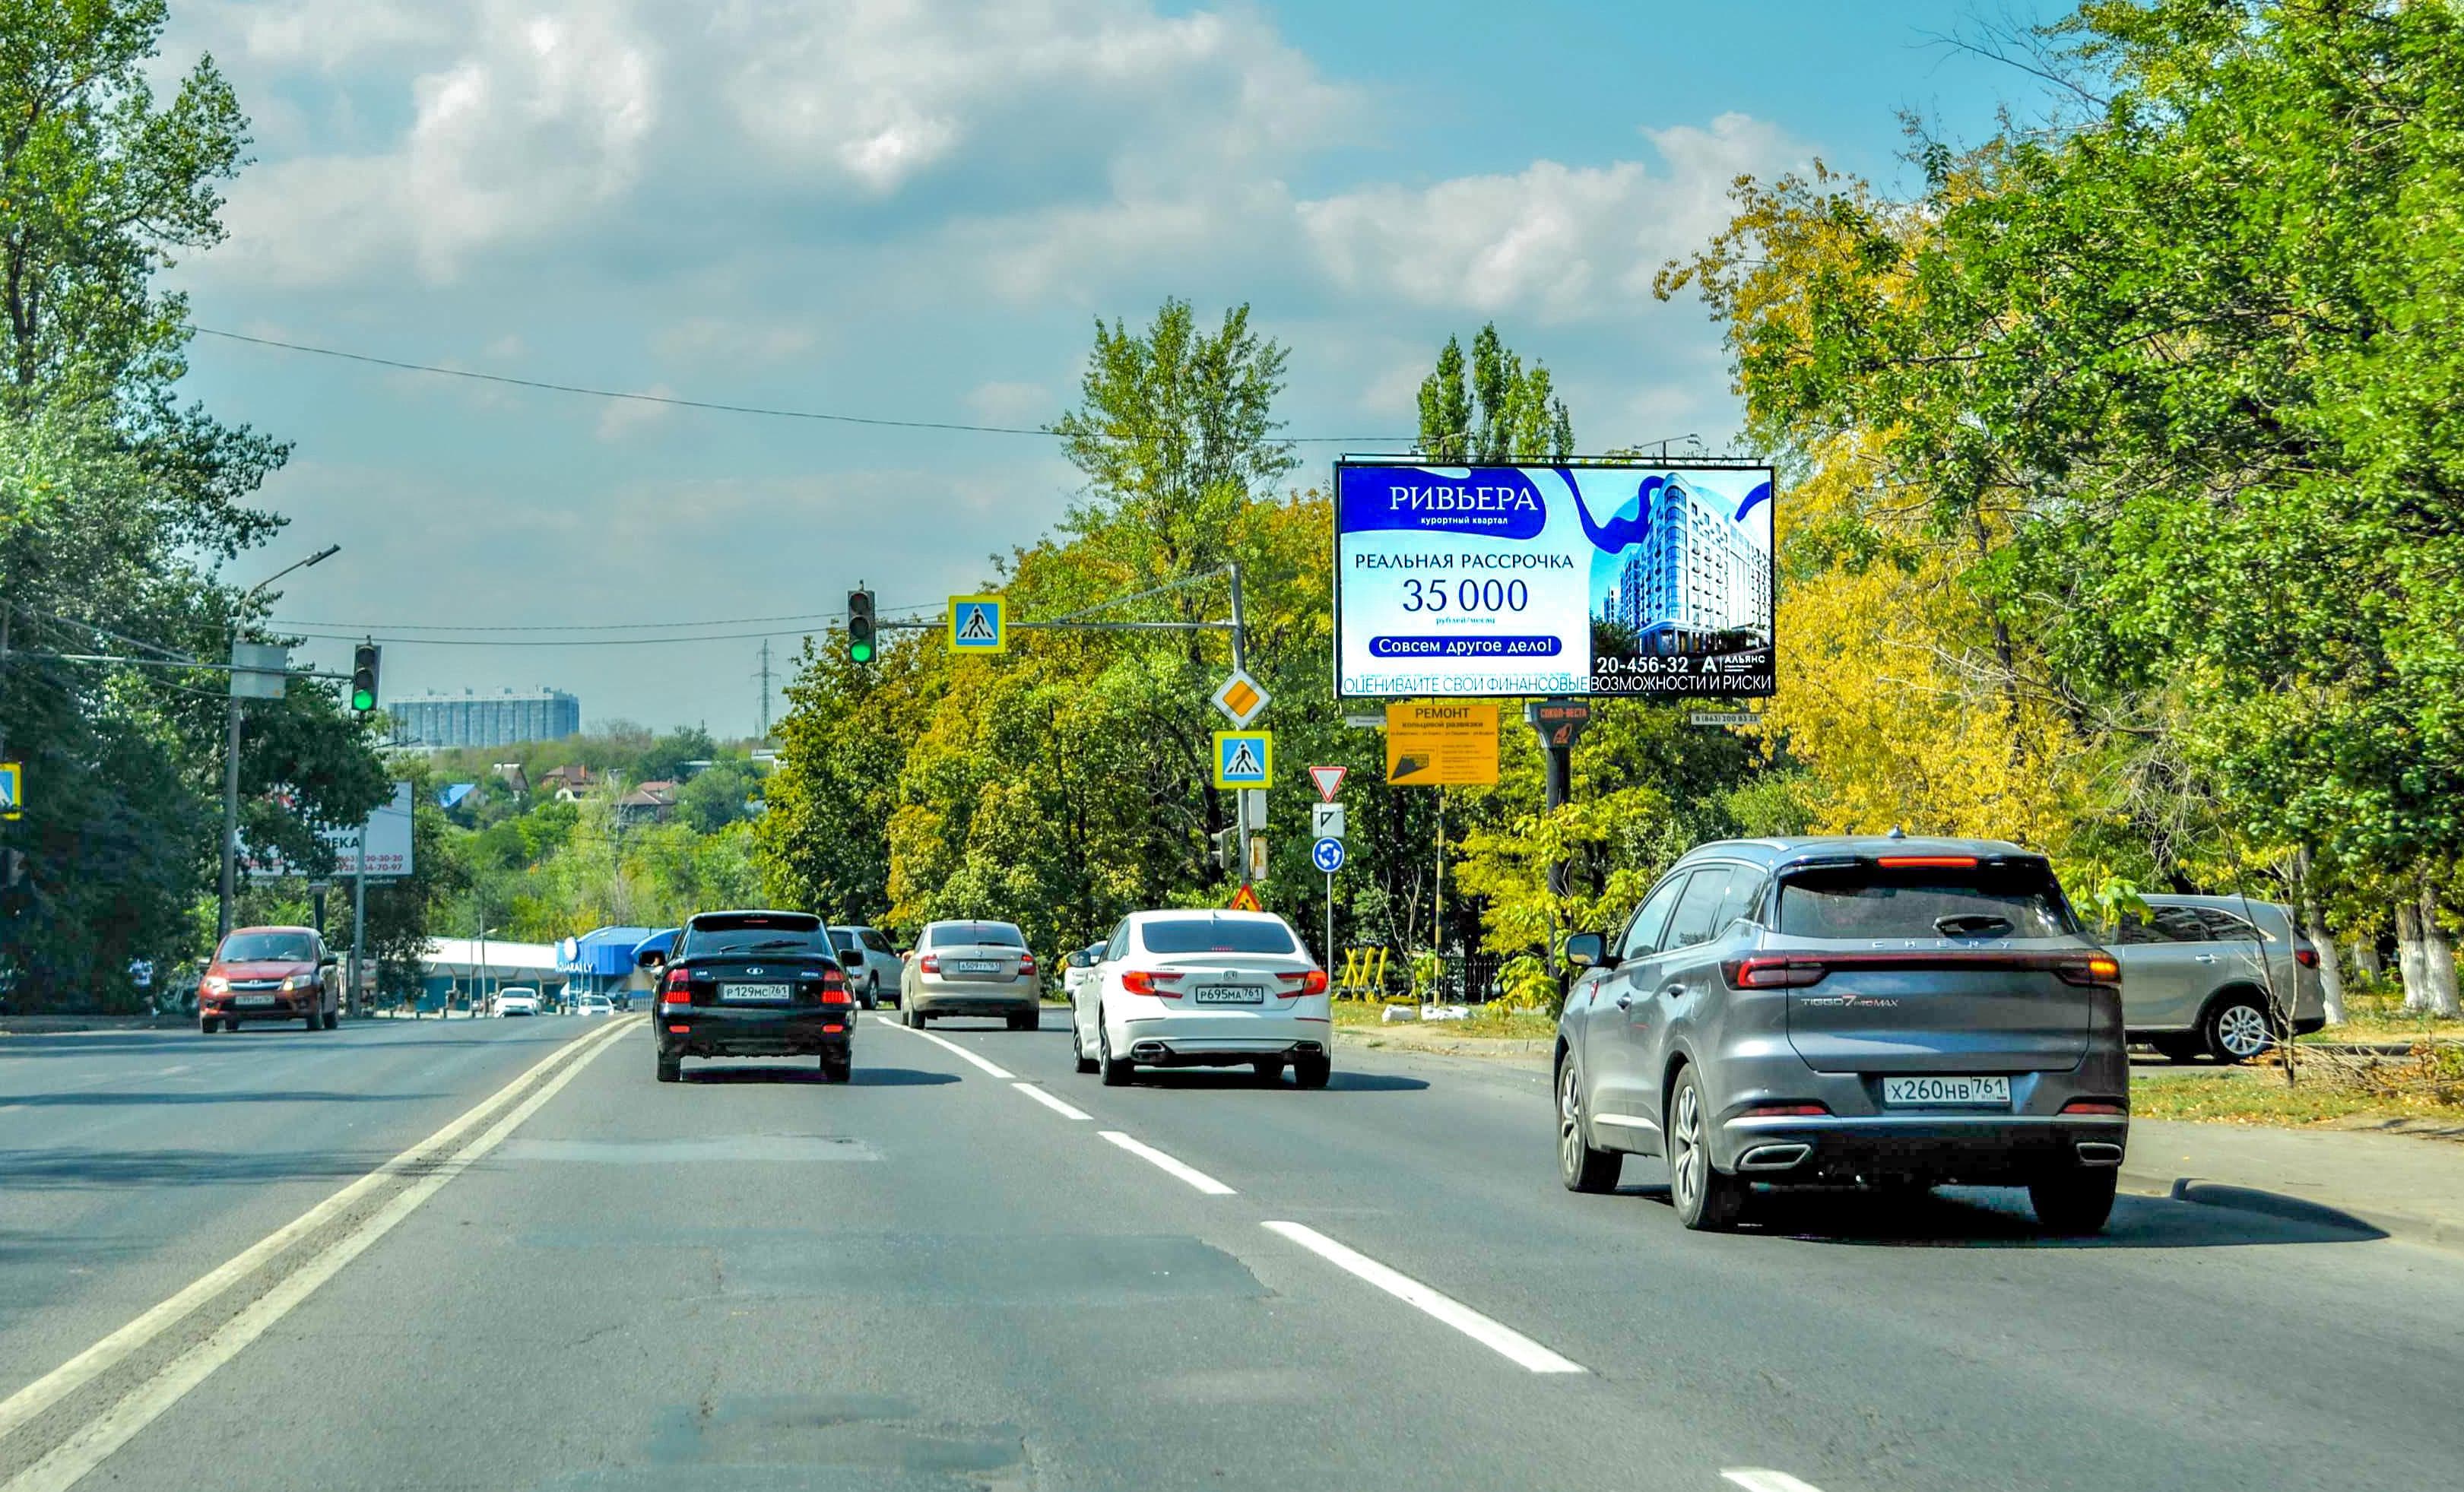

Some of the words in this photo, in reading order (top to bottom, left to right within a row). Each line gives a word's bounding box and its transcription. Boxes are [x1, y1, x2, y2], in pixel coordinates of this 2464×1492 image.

[1389, 486, 1539, 510] РИВЬЕРА
[1421, 516, 1470, 525] курортный
[1356, 554, 1454, 569] РЕАЛЬНАЯ
[1461, 554, 1574, 569] РАССРОЧКА
[1403, 579, 1448, 612] 35
[1458, 579, 1528, 612] 000
[1378, 638, 1440, 653] Совсем
[1446, 641, 1502, 655] другое
[1507, 638, 1552, 654] дело!
[1597, 657, 1689, 673] 20-456-32
[1724, 655, 1765, 664] АЛЬЯНС
[1444, 676, 1483, 692] СВОИ
[1487, 676, 1588, 692] ФИНАНСОВЫЕ
[1590, 676, 1706, 691] ВОЗМОЖНОСТИ
[1710, 676, 1720, 690] И
[1723, 675, 1771, 690] РИСКИ
[1415, 708, 1470, 718] РЕМОНТ
[1872, 940, 2009, 949] CHERY
[771, 985, 787, 995] 761
[1200, 989, 1242, 999] Р695МА
[1243, 988, 1259, 997] 761
[1892, 1080, 1969, 1100] Х260НВ
[1973, 1079, 2003, 1094] 761
